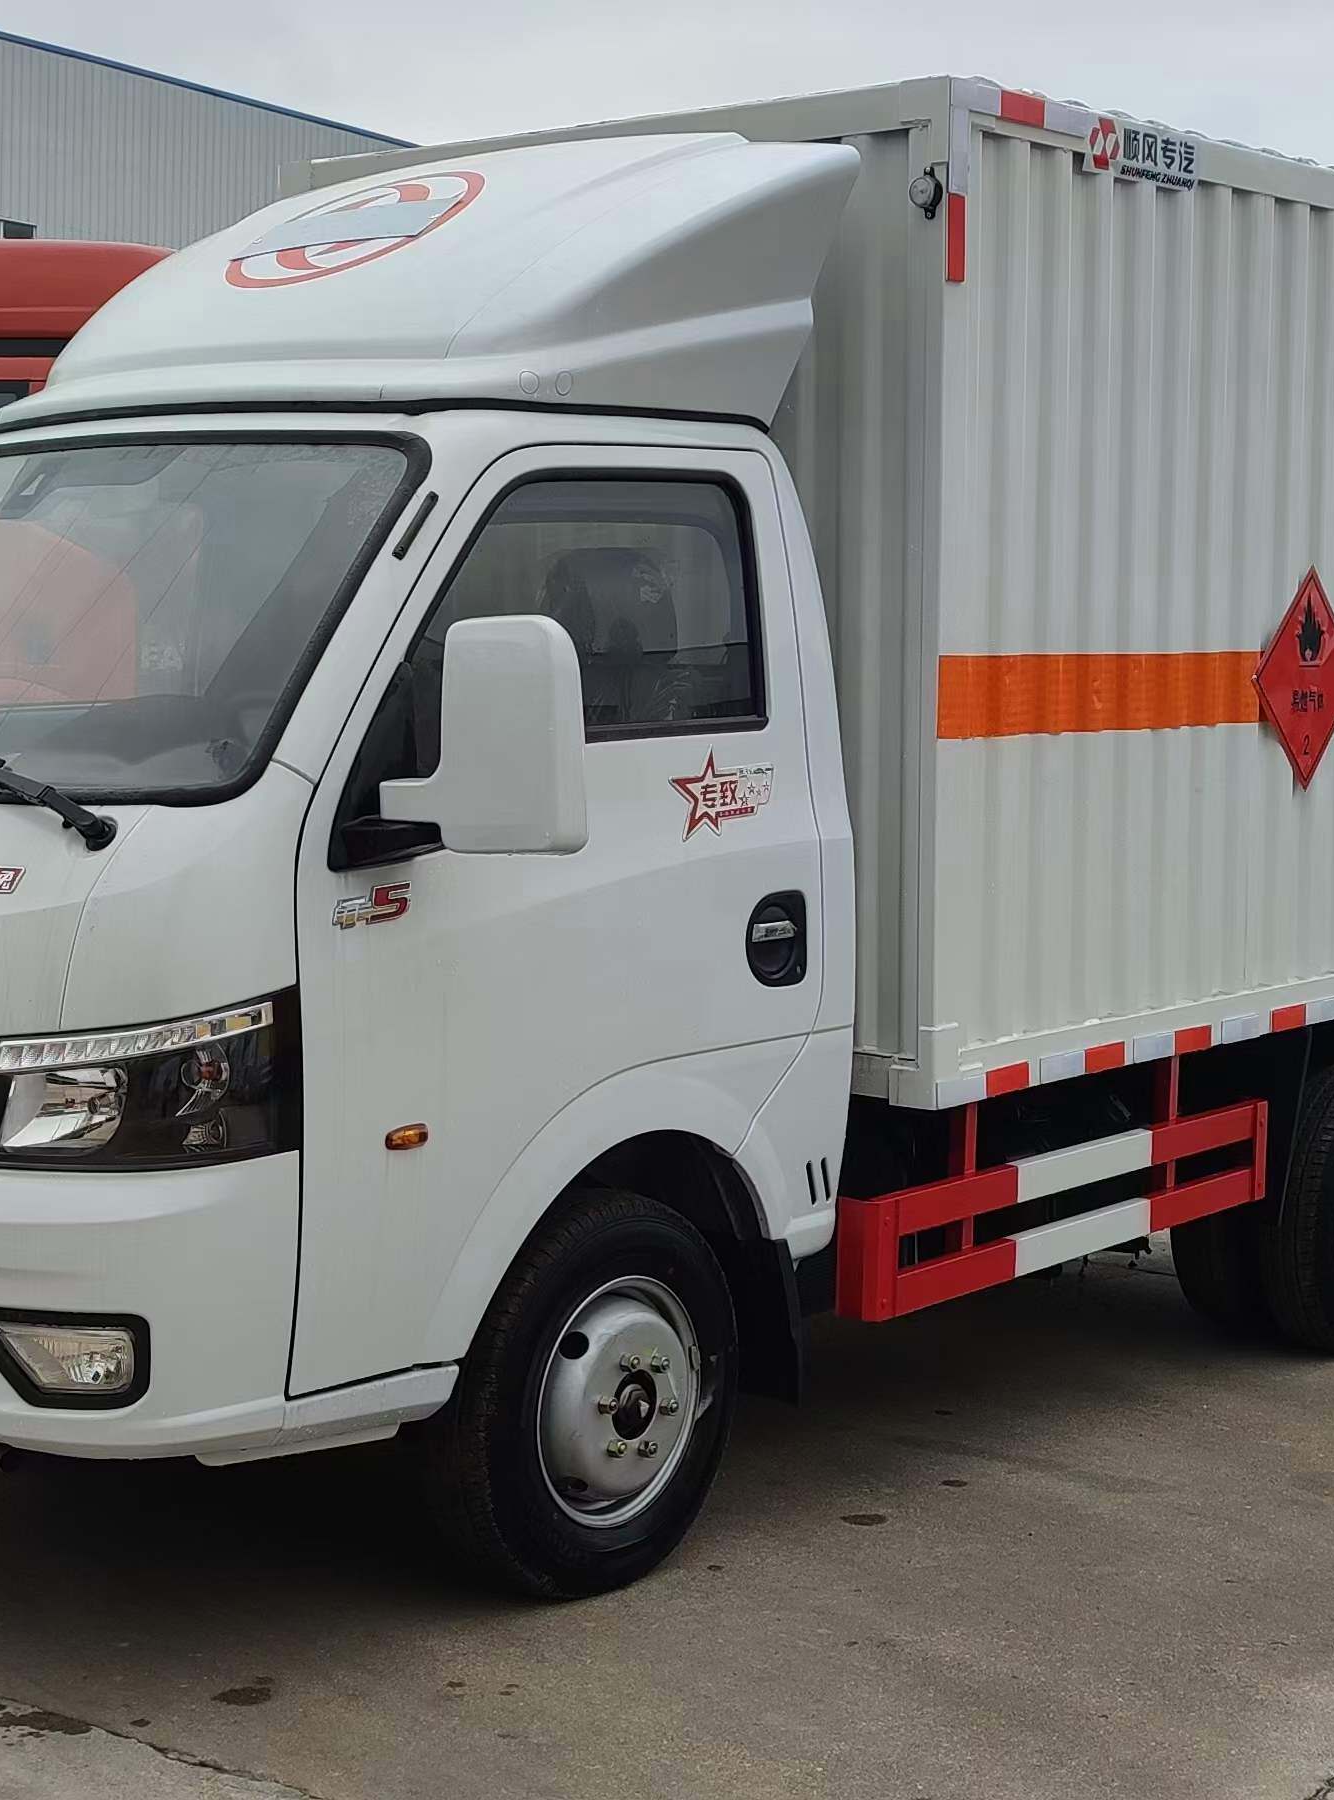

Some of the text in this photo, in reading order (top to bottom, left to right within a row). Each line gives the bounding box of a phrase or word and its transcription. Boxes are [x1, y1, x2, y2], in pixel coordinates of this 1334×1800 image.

[1123, 128, 1195, 174] 顺风专汽
[1120, 164, 1161, 182] SHUNFENG
[1302, 733, 1311, 755] 2
